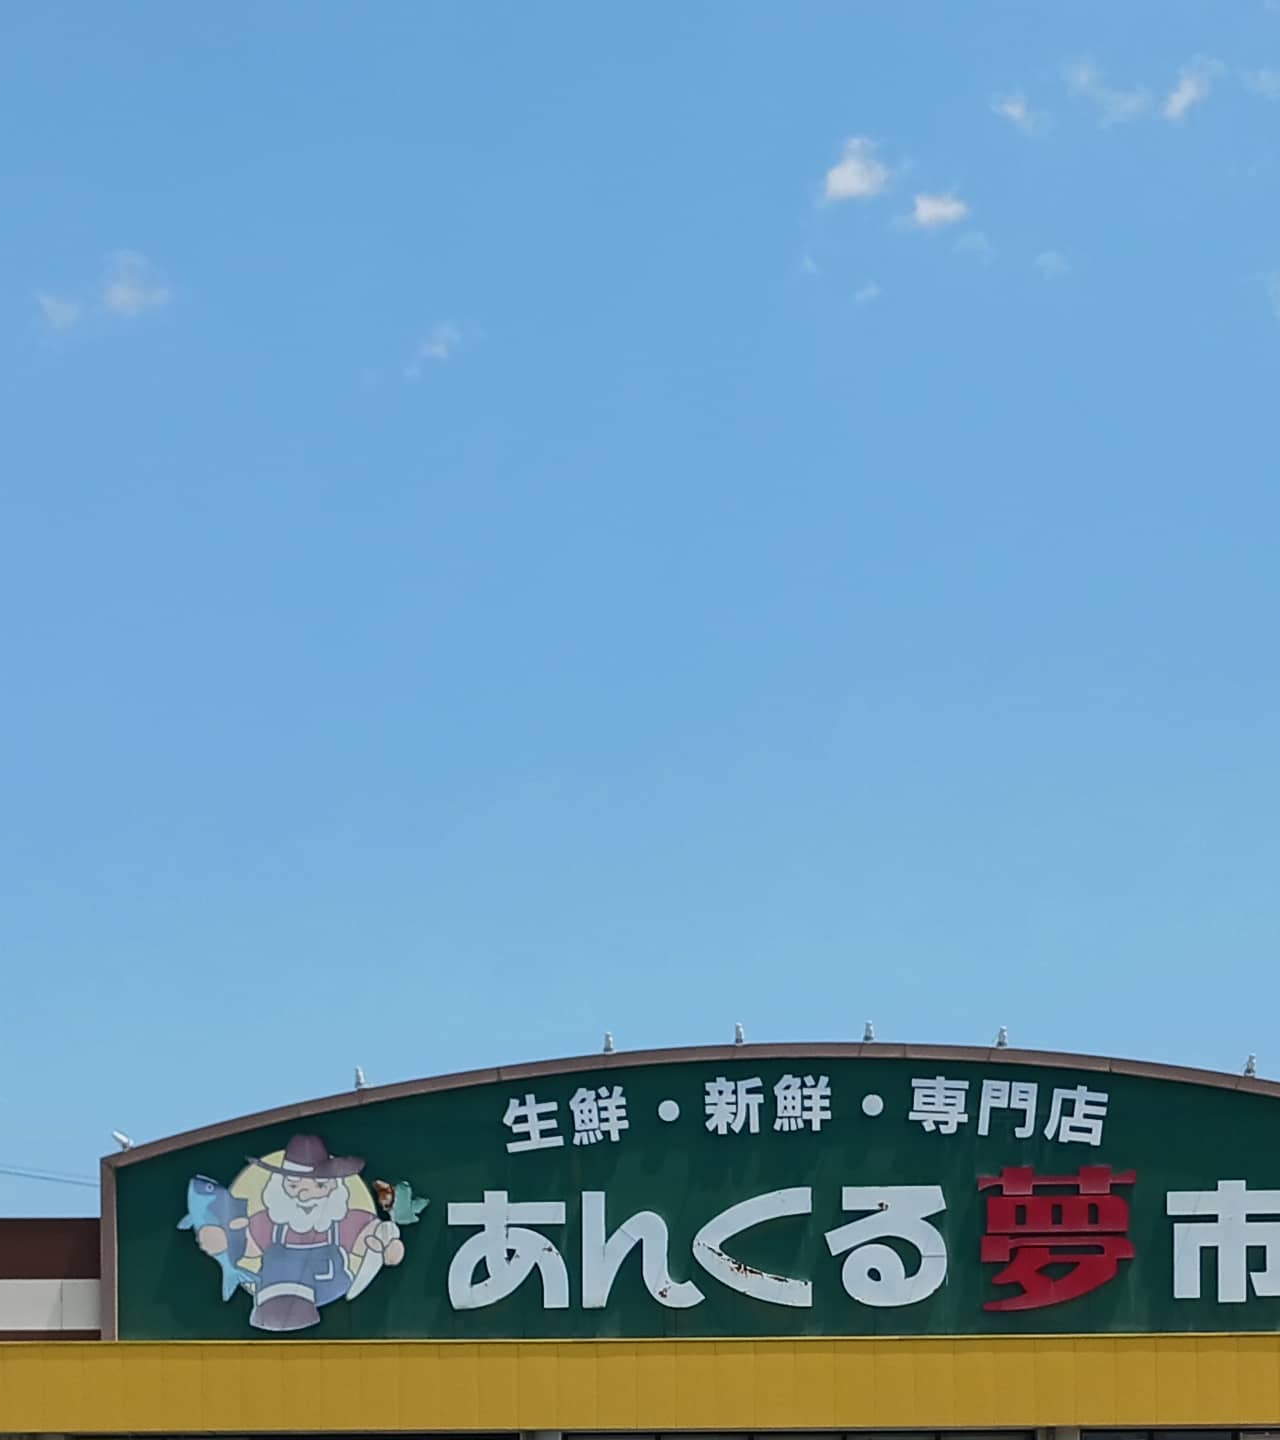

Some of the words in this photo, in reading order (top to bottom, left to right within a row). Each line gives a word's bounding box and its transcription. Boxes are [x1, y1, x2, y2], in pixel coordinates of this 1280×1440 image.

[502, 1074, 1110, 1154] 生鮮・新鮮・専門店
